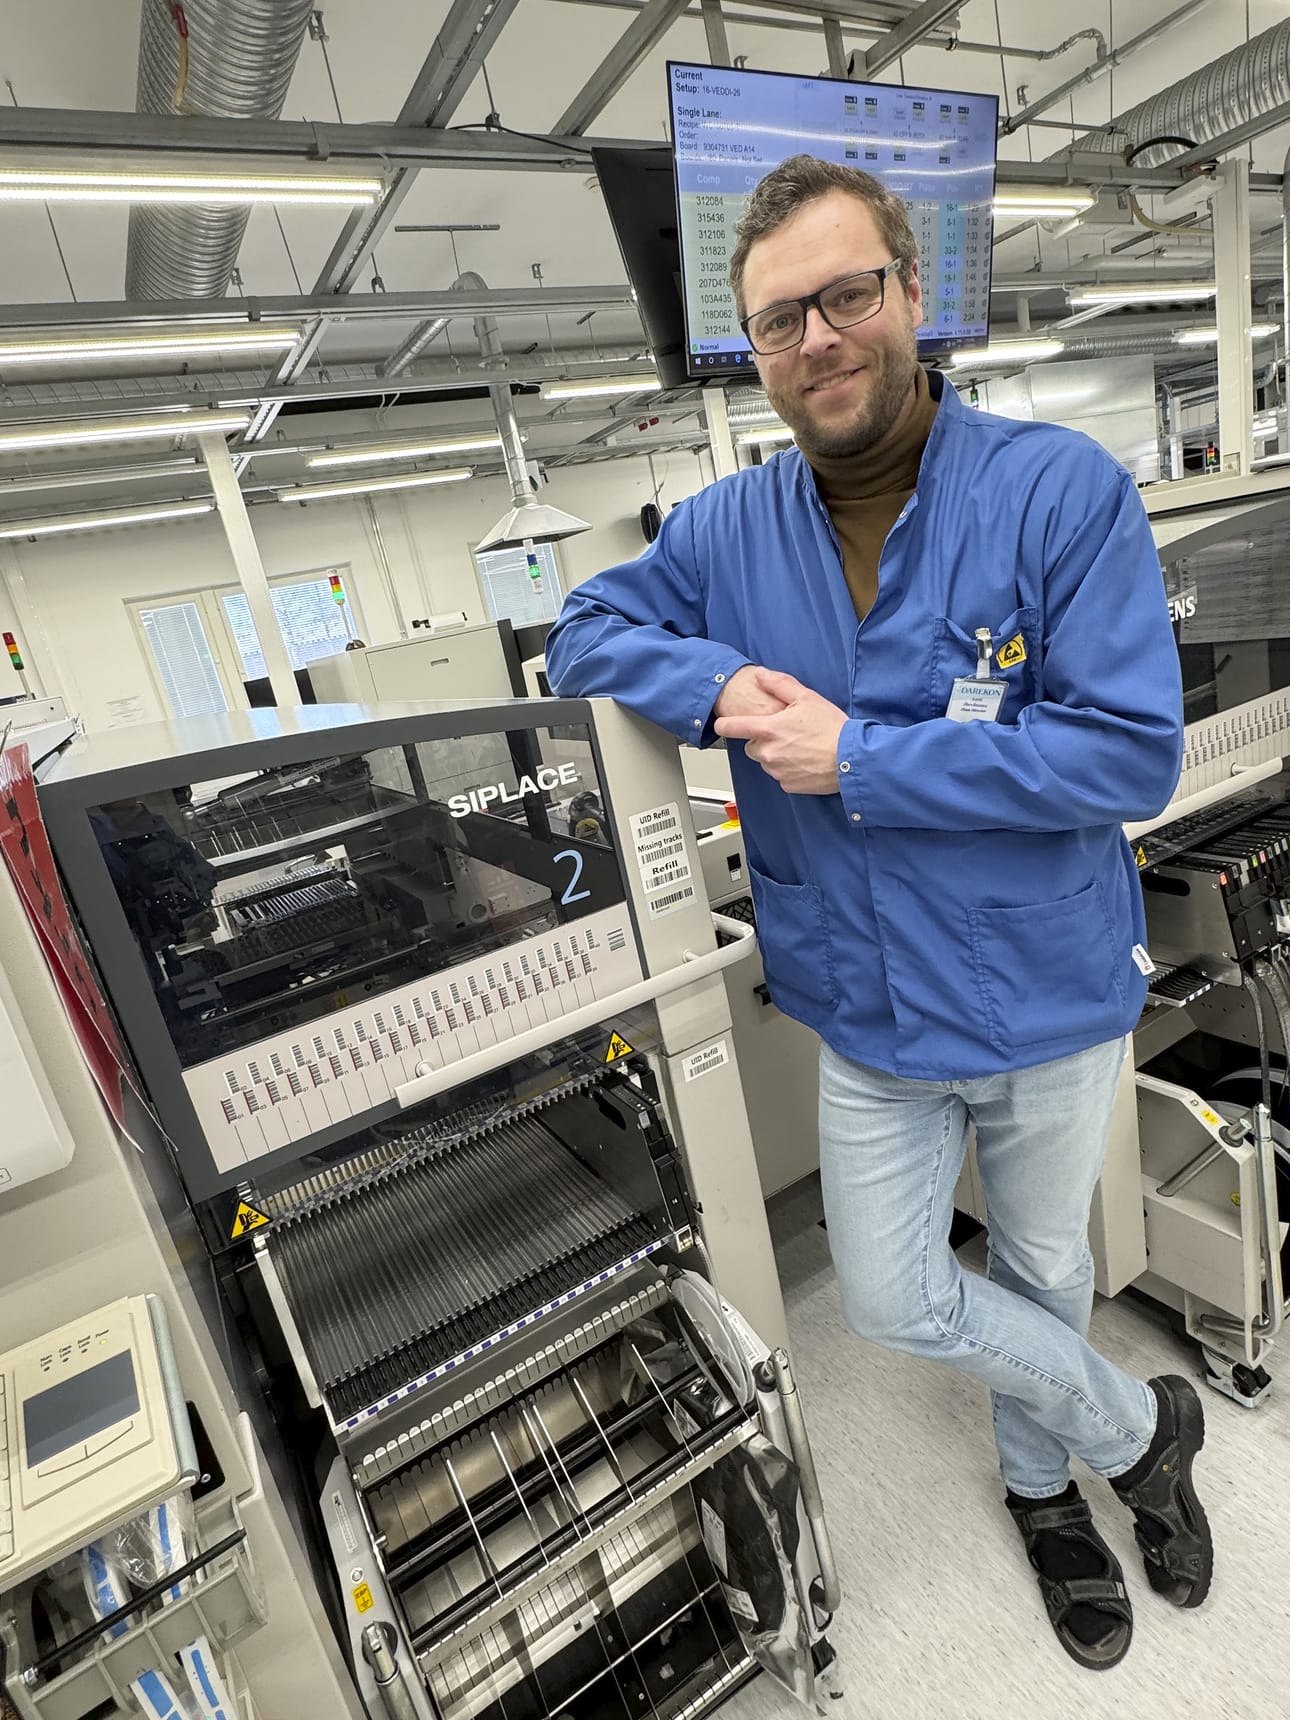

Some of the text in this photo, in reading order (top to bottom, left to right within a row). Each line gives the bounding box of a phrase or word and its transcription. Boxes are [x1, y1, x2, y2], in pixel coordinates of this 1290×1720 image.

[674, 69, 703, 80] Current
[675, 82, 700, 94] Setup:
[677, 106, 722, 118] Single Lane:
[697, 174, 720, 187] Comp
[697, 213, 725, 223] 315436
[698, 229, 726, 240] 312106
[700, 246, 727, 256] 311823
[700, 262, 728, 272] 312089
[700, 294, 732, 304] 103A435
[701, 310, 732, 320] 118D062
[704, 325, 731, 334] 312144
[961, 686, 1001, 696] DAREKON
[447, 761, 578, 818] SIPLACE
[639, 808, 671, 824] UID Refill
[637, 833, 683, 853] Missing tracks
[652, 859, 679, 875] Refill
[552, 850, 592, 906] 2
[691, 1047, 719, 1065] UID Refill
